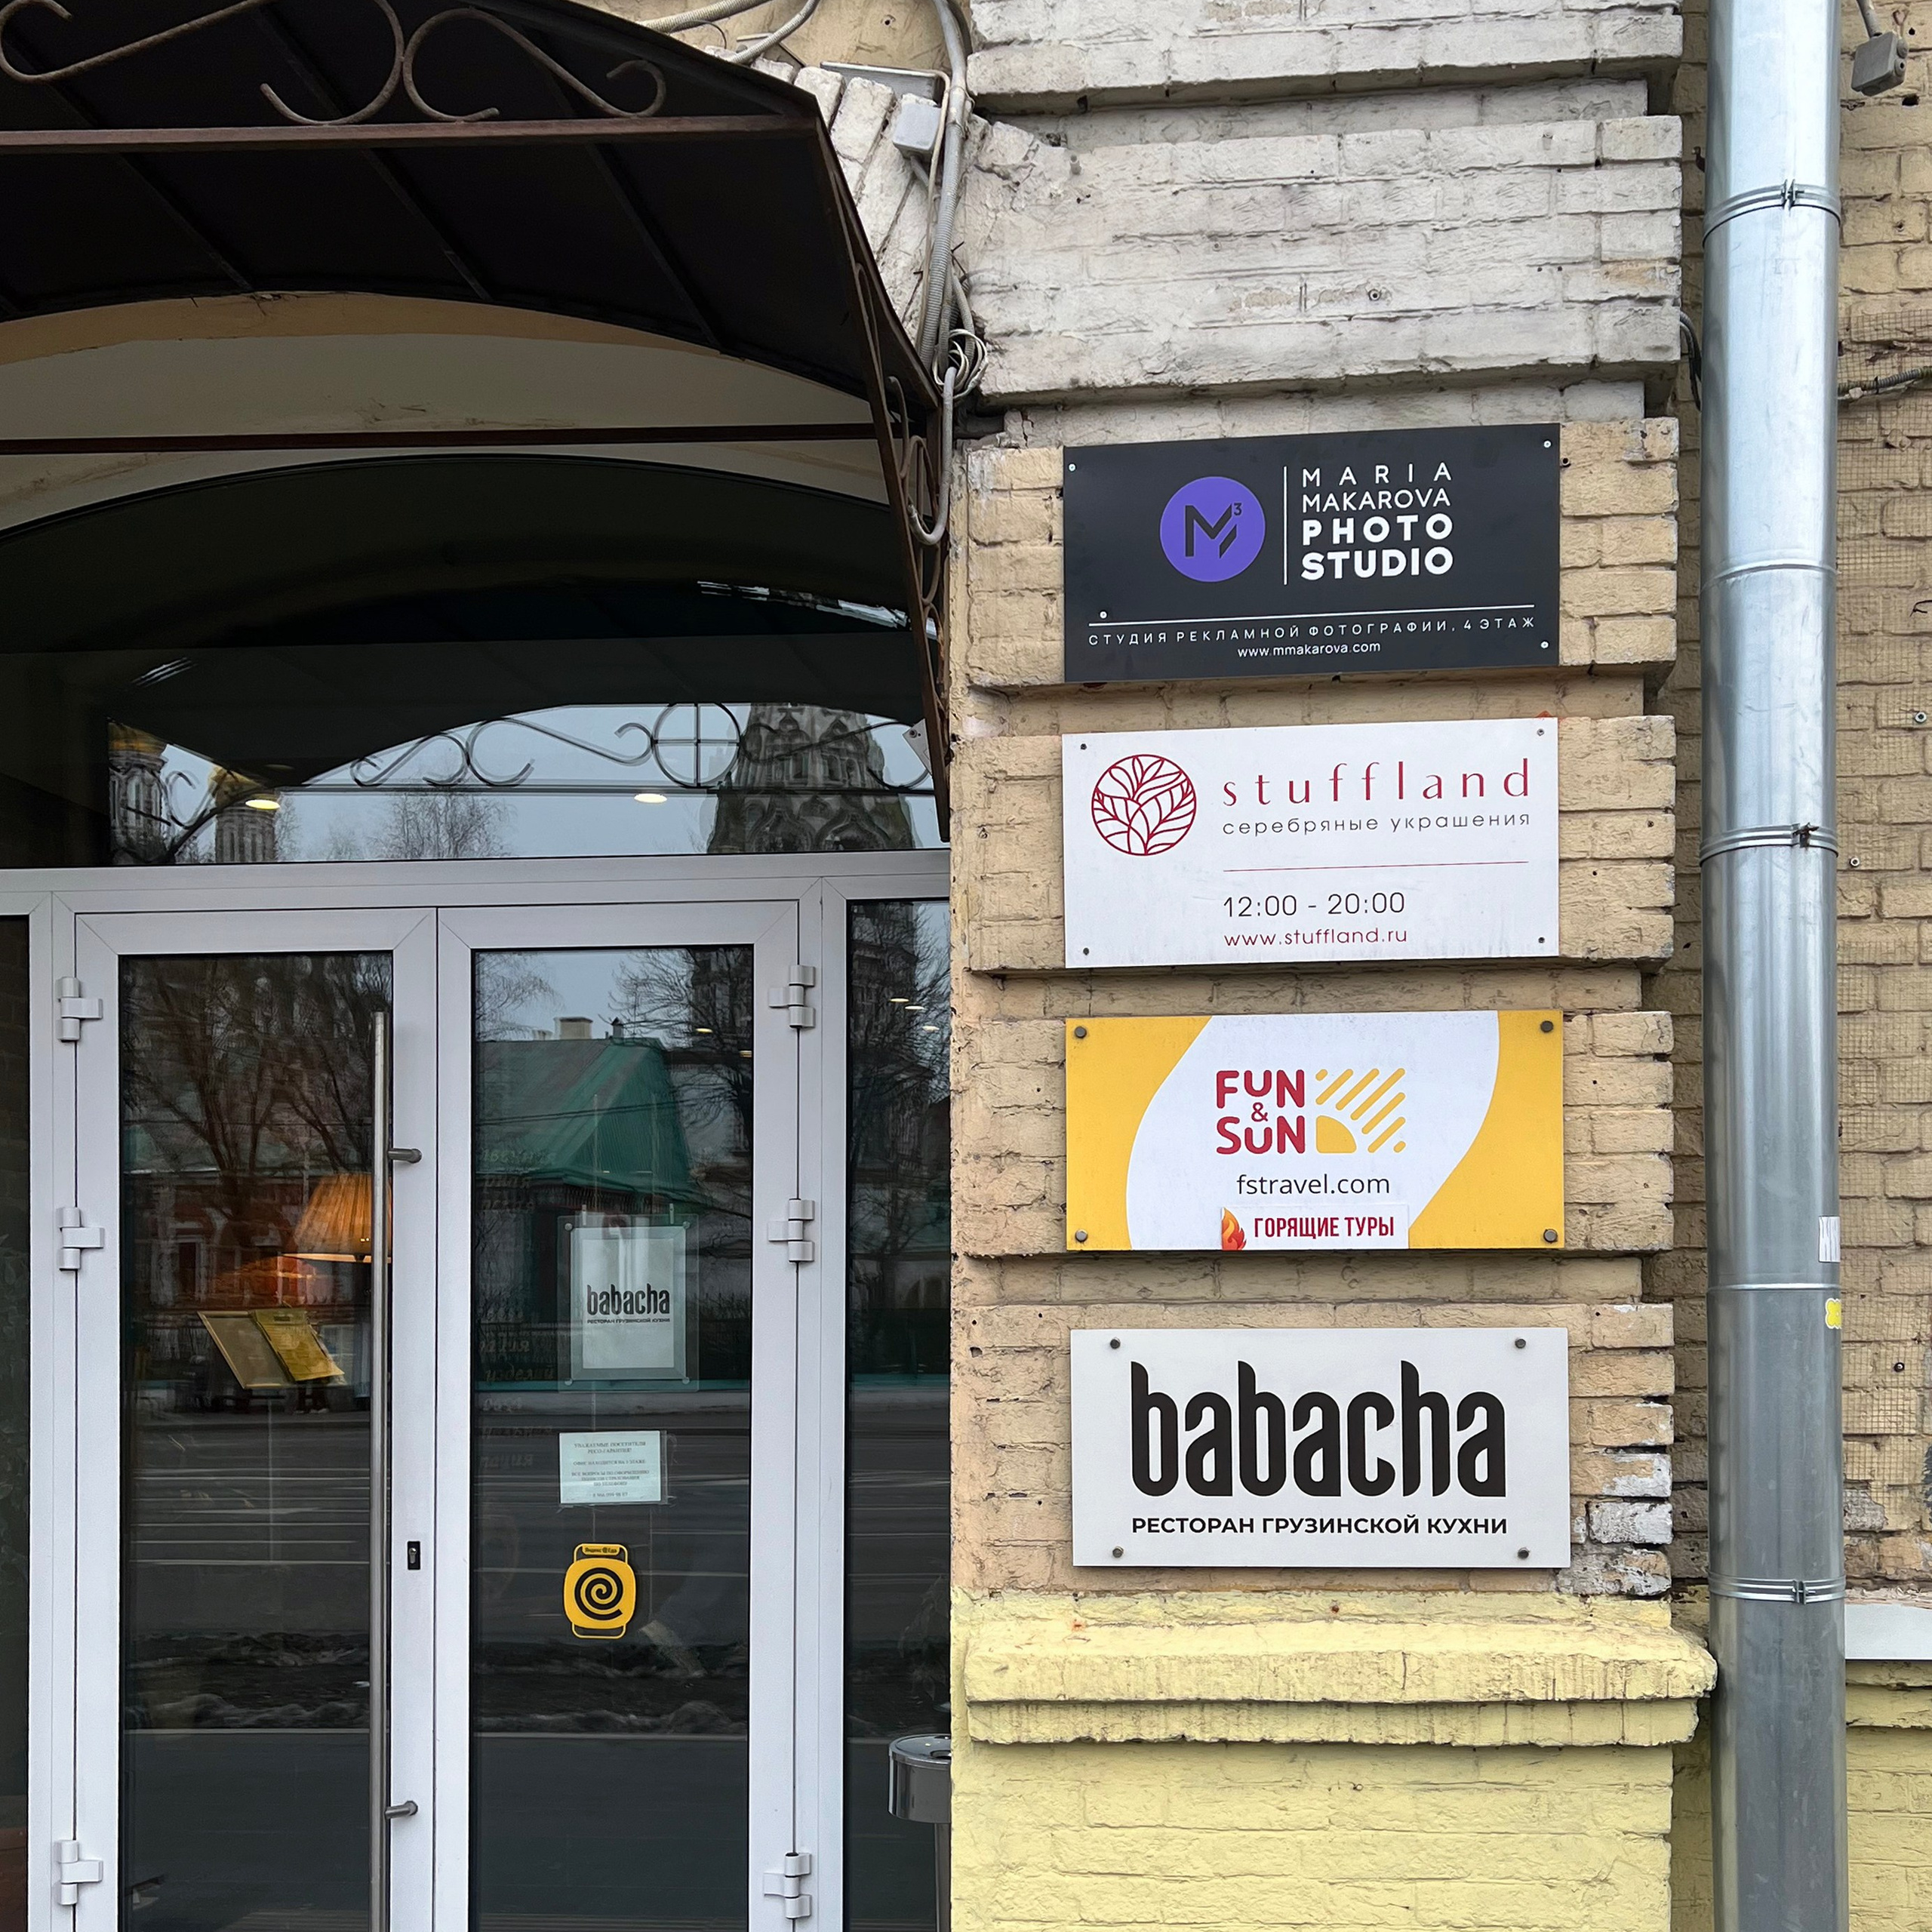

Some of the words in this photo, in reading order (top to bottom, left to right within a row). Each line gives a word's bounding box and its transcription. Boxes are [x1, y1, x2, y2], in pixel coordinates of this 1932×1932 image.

[1303, 462, 1452, 488] MARIA
[1303, 488, 1451, 513] MAKAROVA
[1303, 513, 1454, 546] PHOTO
[1301, 546, 1454, 580] STUDIO
[1088, 632, 1168, 646] СТУДИЯ
[1177, 625, 1299, 642] РЕКЛАМНОЙ
[1463, 619, 1472, 630] 4
[1479, 616, 1534, 629] ЭТАЖ
[1237, 642, 1381, 657] www.mmakarova.com
[1223, 757, 1529, 807] stuffland
[1223, 817, 1378, 837] серебряные
[1390, 813, 1530, 832] украшения
[1223, 894, 1297, 918] 12:00
[1327, 891, 1405, 915] 20:00
[1223, 927, 1407, 946] www.stuffland.ru
[1216, 1069, 1306, 1109] FUN
[1251, 1102, 1269, 1122] &
[1216, 1115, 1306, 1155] SUN
[1236, 1174, 1390, 1195] fstravel.com
[1254, 1217, 1340, 1240] ГОРЯЩИЕ
[1344, 1216, 1395, 1237] ТУРЫ
[587, 1283, 670, 1315] babacha
[1131, 1361, 1506, 1497] babacha
[1132, 1517, 1254, 1534] РЕСТОРАН
[1262, 1514, 1420, 1534] ГРУЗИНСКОЙ
[1427, 1518, 1507, 1534] КУХНИ
